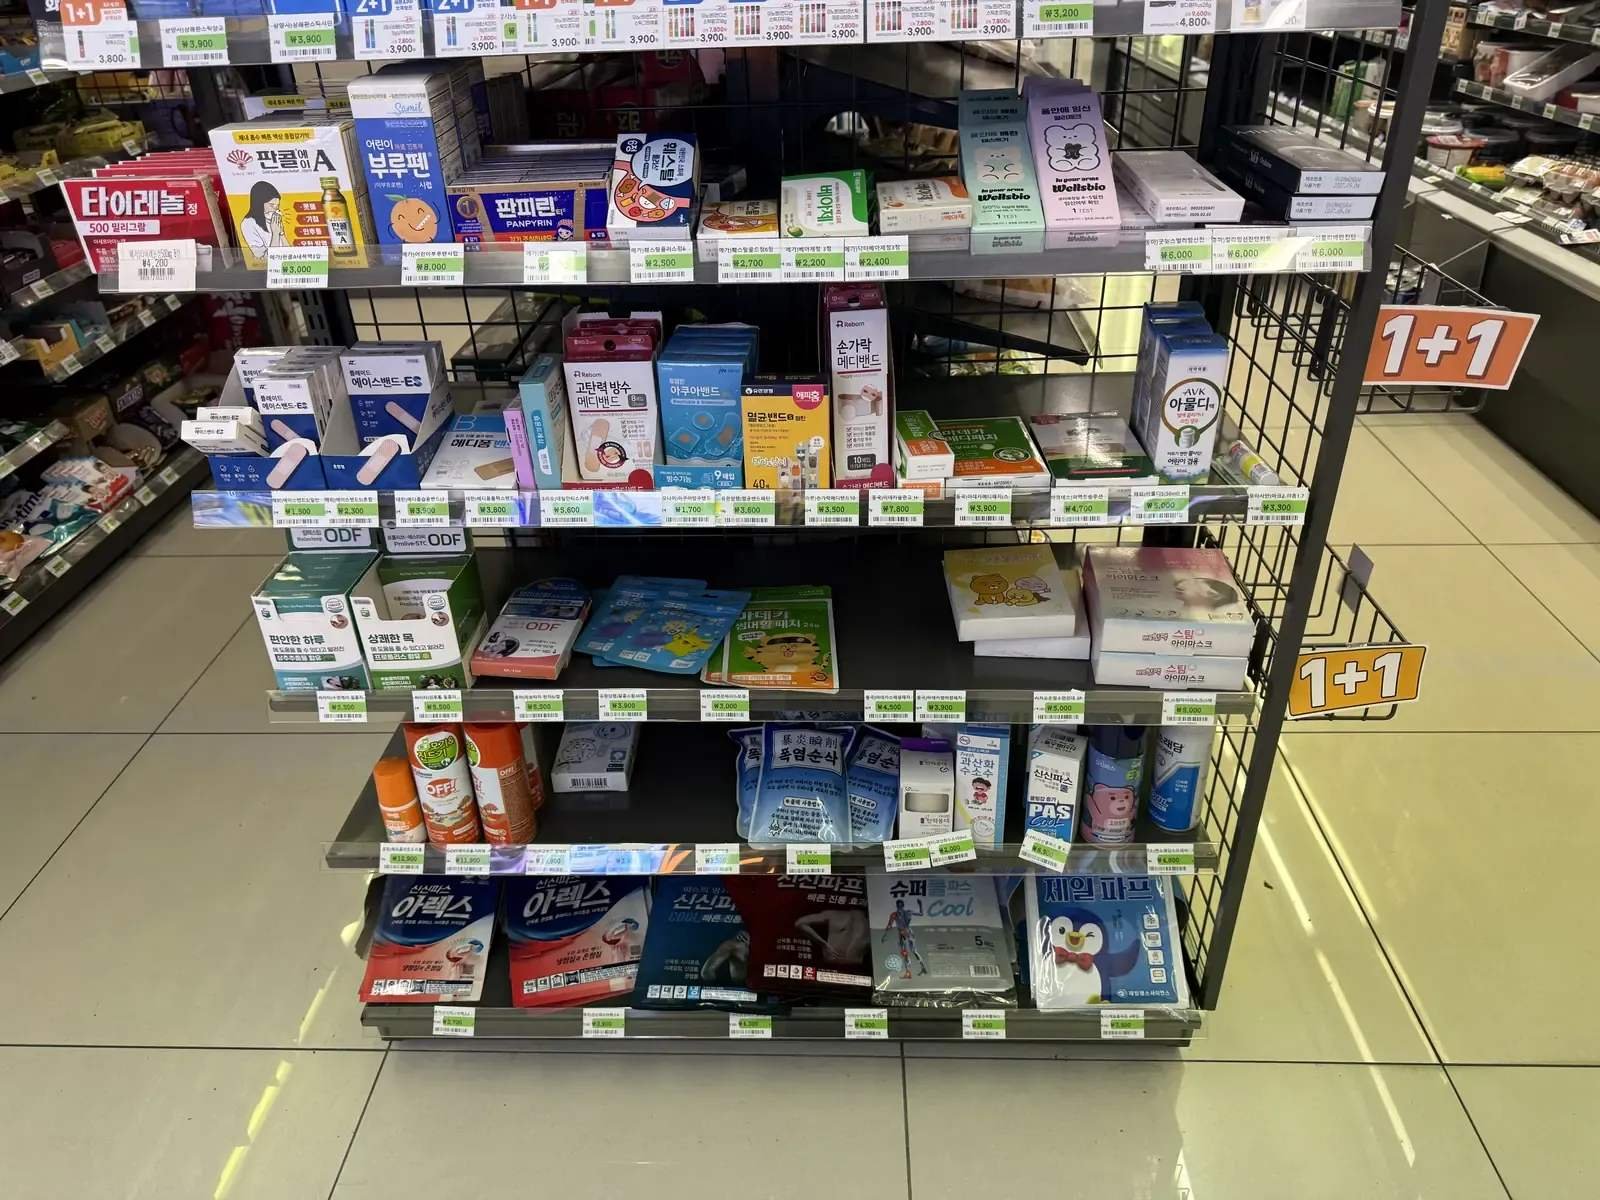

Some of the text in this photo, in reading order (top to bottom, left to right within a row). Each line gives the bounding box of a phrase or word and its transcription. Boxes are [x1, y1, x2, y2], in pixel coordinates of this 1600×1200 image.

[65, 3, 96, 23] 1+1
[366, 139, 394, 150] 어린이
[256, 150, 298, 170] 판콜
[313, 149, 336, 172] A
[367, 152, 431, 180] 부루펜
[659, 142, 677, 182] 훼스탈
[419, 181, 433, 190] 시럽
[1052, 182, 1106, 193] Wellsbio
[80, 186, 198, 217] 타이레놀 정
[977, 193, 1031, 202] Wellsbio
[495, 196, 555, 218] 판피린
[816, 184, 834, 225] 베아제
[89, 222, 146, 233] 500 밀리그람
[506, 219, 553, 228] PANPYRIN
[645, 258, 676, 267] ₩2,500
[732, 259, 764, 267] ₩2,700
[795, 258, 826, 267] ₩2,200
[836, 337, 873, 355] 손가락
[1381, 313, 1507, 379] 1+1
[837, 354, 882, 370] 메디밴드
[575, 380, 632, 395] 고탄력 방수
[670, 386, 721, 397] 아쿠아밴드
[1184, 387, 1206, 396] AVK
[577, 395, 622, 408] 메디밴드
[1169, 397, 1210, 411] 아물디
[324, 528, 362, 543] ODF
[428, 533, 462, 546] ODF
[526, 621, 561, 632] ODF
[269, 634, 325, 645] 편안한 하루
[368, 633, 415, 644] 상쾌한 목
[1172, 629, 1194, 640] 스팀
[1171, 640, 1213, 649] 아이마스크
[1166, 664, 1187, 674] 스팀
[1164, 675, 1205, 683] 아이마스크
[1299, 650, 1404, 709] 1+1
[779, 746, 839, 766] 폭염순삭
[960, 756, 996, 769] 과산화
[960, 766, 994, 778] 수소수
[1033, 768, 1073, 786] 신신파스
[426, 777, 457, 795] OFF!
[1029, 803, 1071, 820] PAS
[409, 884, 452, 894] 신신파스
[535, 876, 580, 889] 신신파스
[776, 875, 864, 894] 신신파프
[1042, 876, 1153, 902] 제일 파프
[522, 879, 611, 918] 아렉스
[391, 894, 473, 920] 아렉스
[927, 897, 974, 917] Cool
